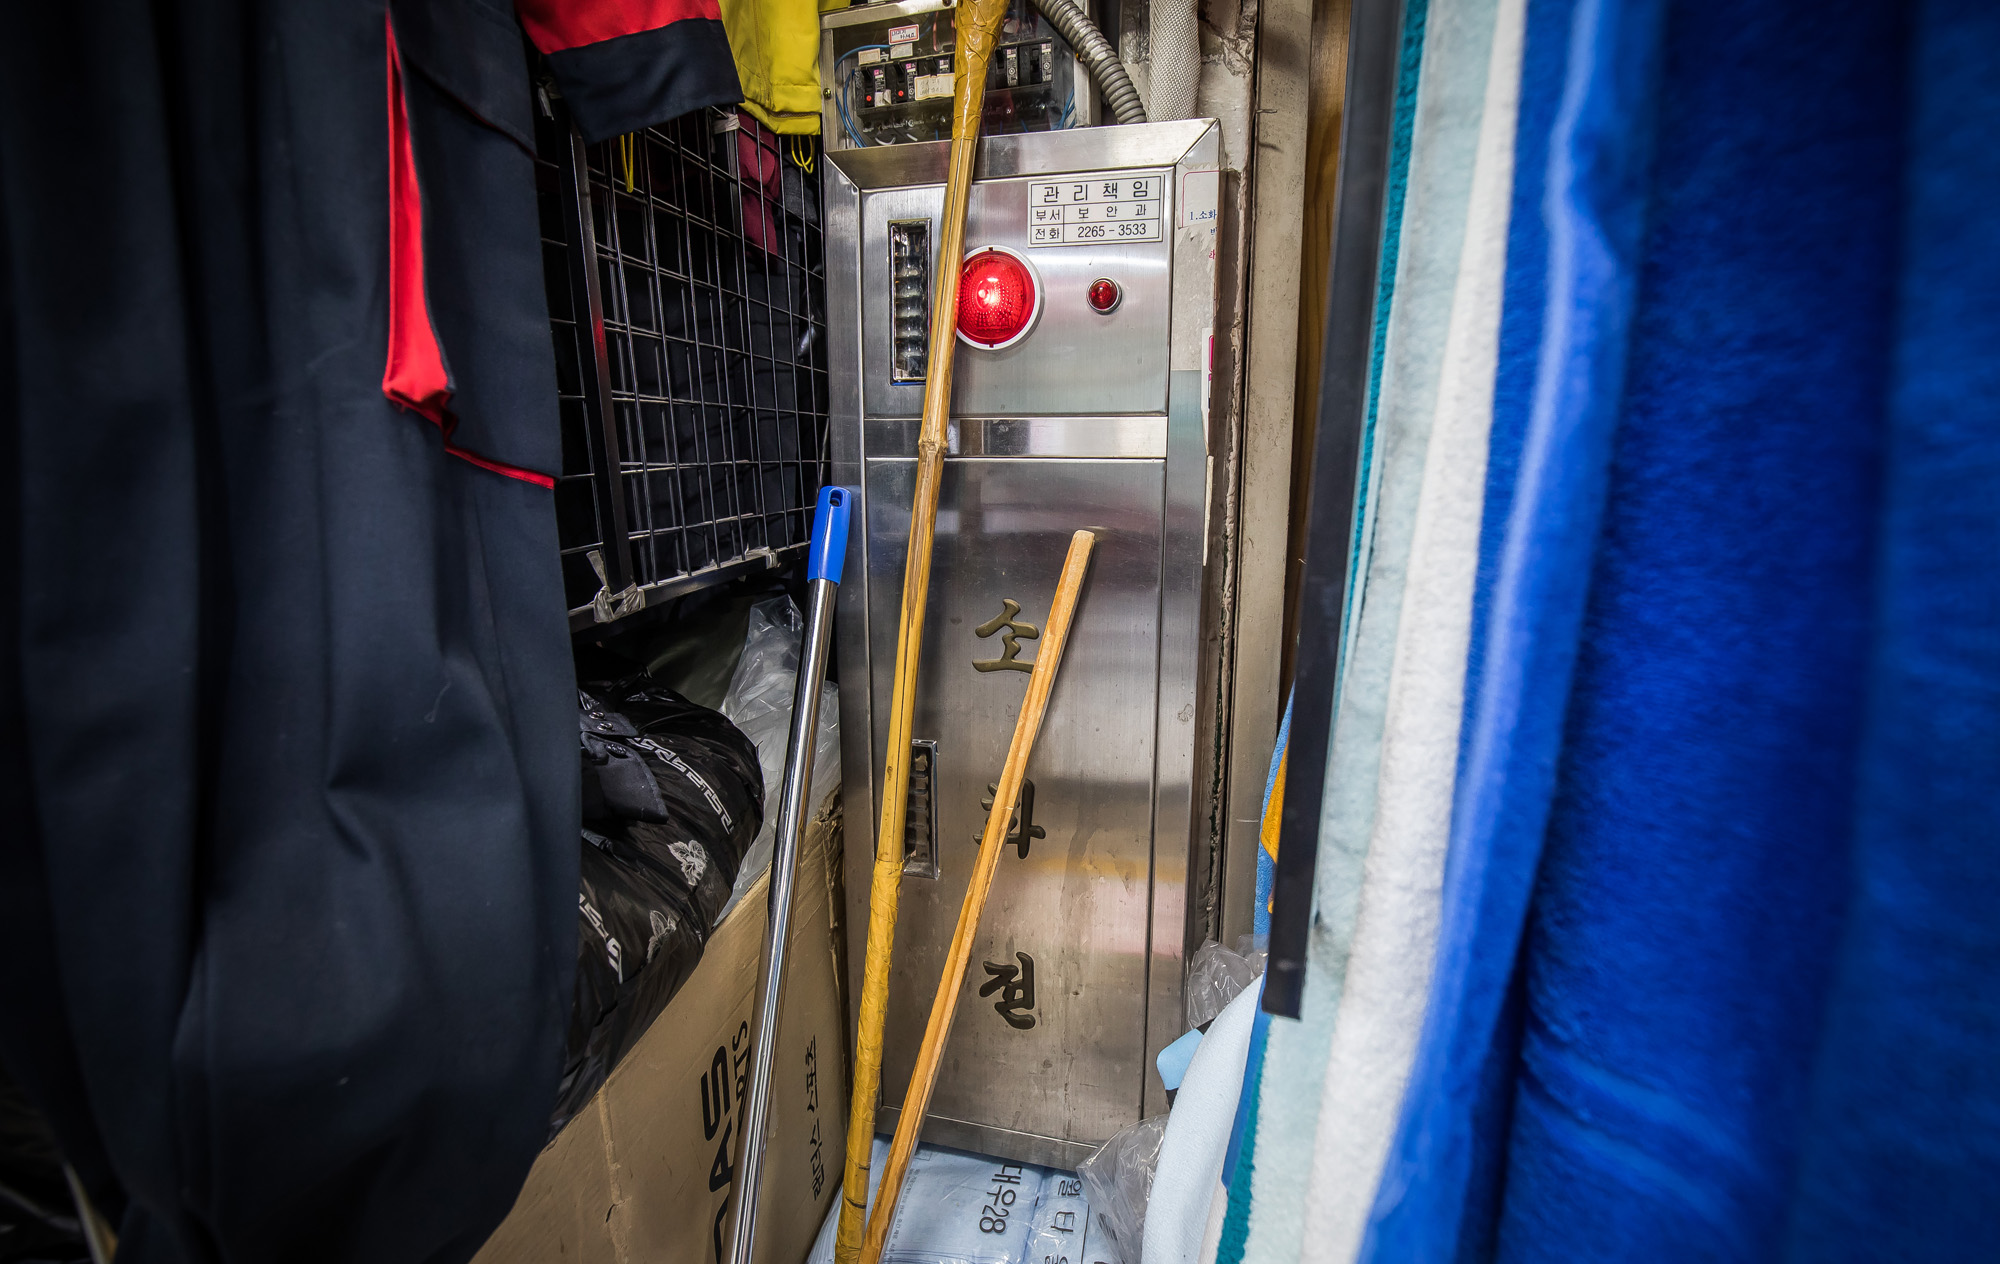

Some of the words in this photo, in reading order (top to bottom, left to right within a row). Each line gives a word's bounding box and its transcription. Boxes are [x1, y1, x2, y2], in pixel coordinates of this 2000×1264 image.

[1035, 209, 1061, 221] 부서
[1035, 227, 1060, 240] 전화
[805, 1035, 819, 1114] 스포츠
